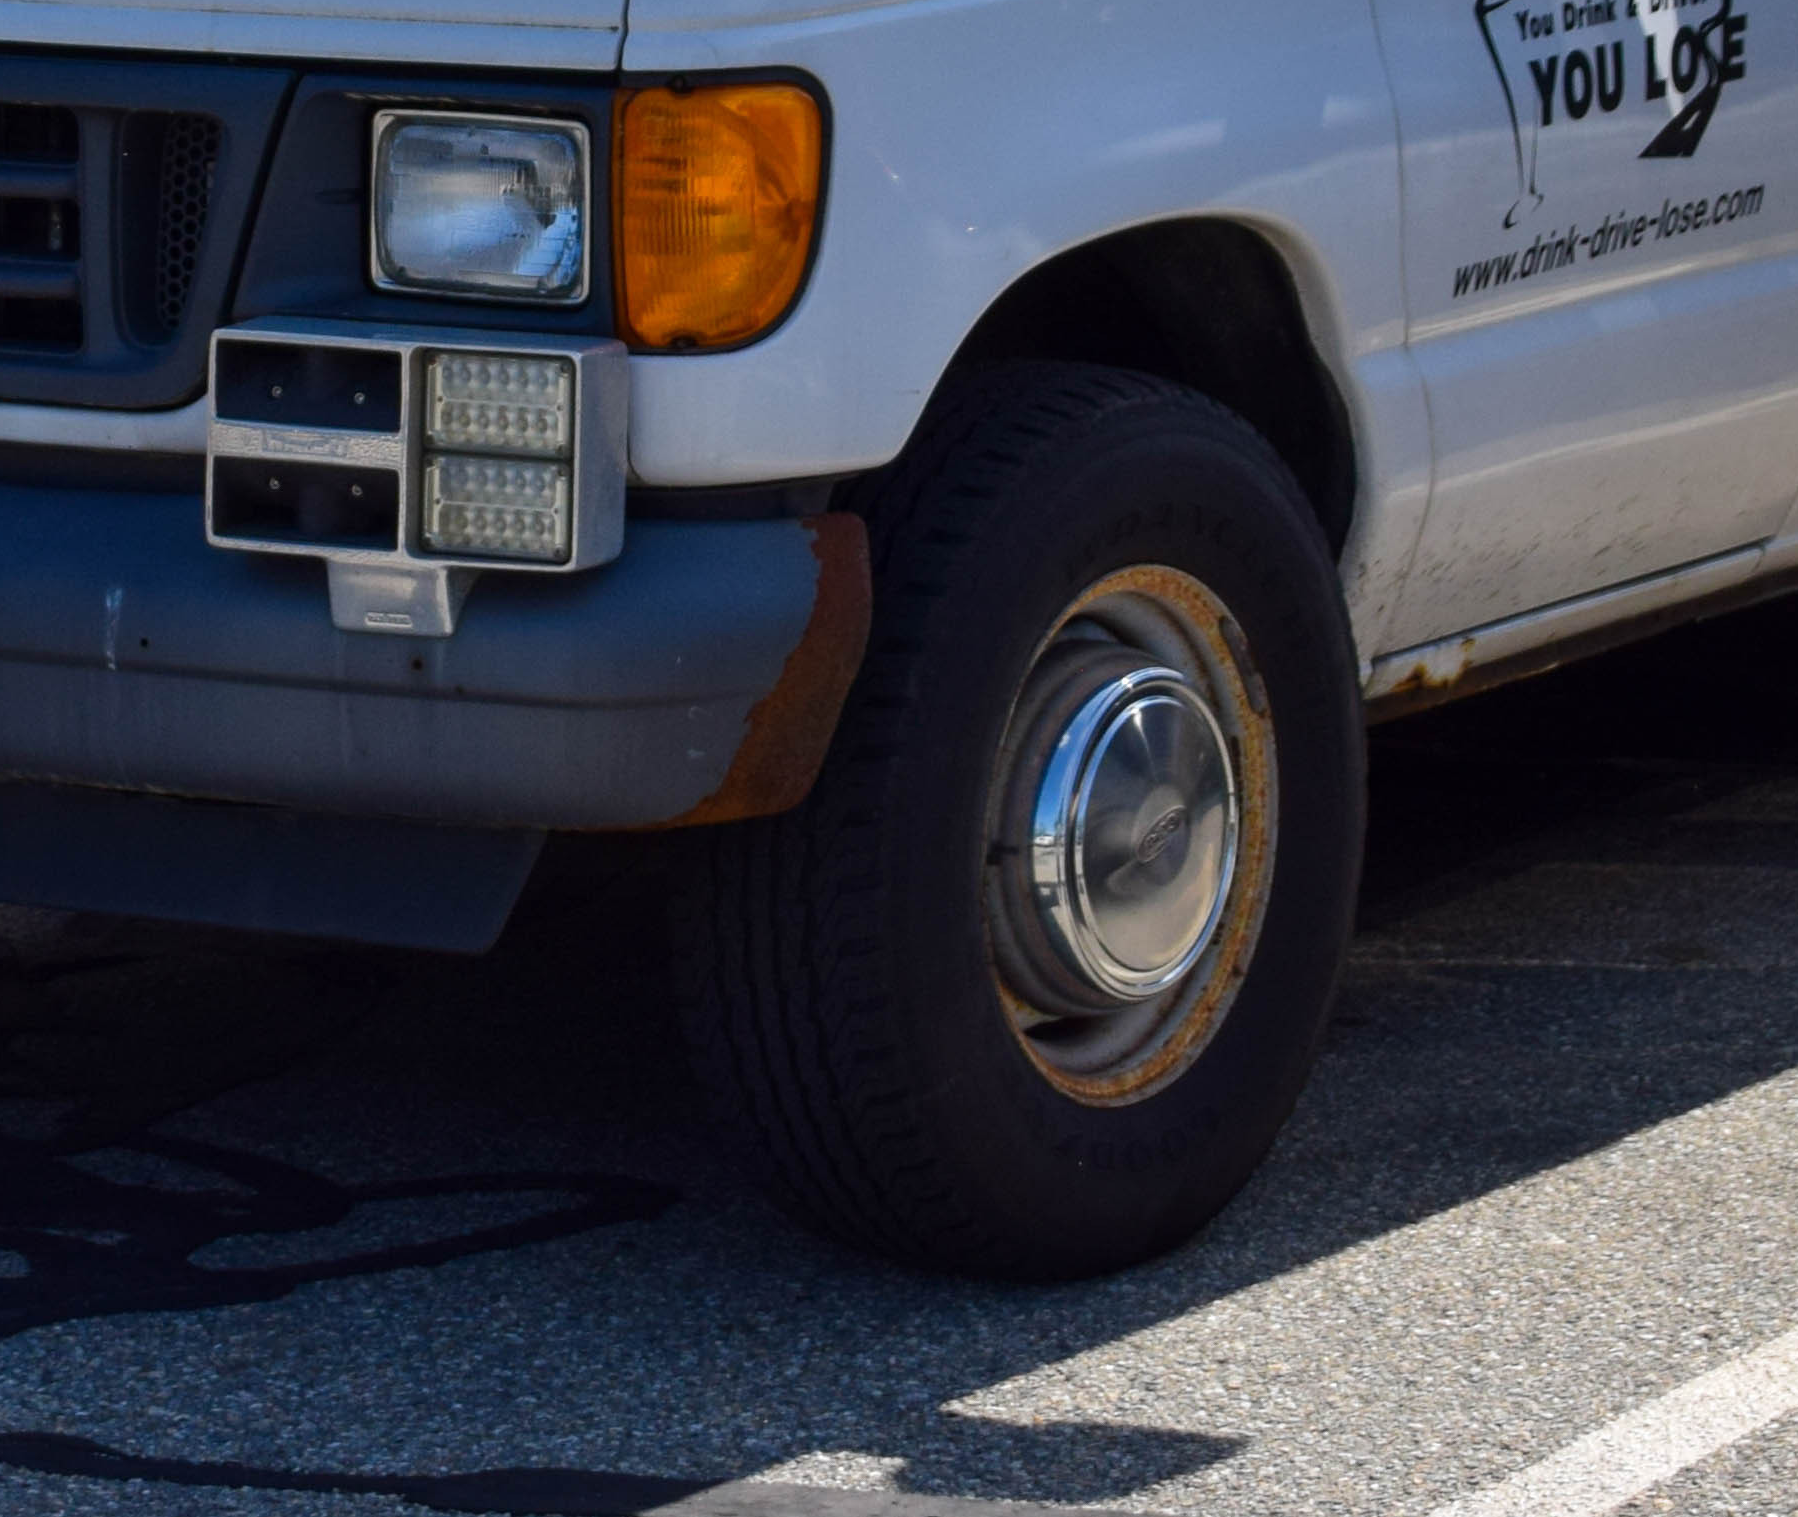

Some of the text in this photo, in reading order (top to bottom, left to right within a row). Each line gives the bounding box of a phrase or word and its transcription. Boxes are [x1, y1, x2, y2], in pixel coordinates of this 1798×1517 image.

[1516, 9, 1553, 41] You
[1528, 41, 1624, 127] YOU
[1451, 185, 1766, 299] www.drink-drive-lose.com
